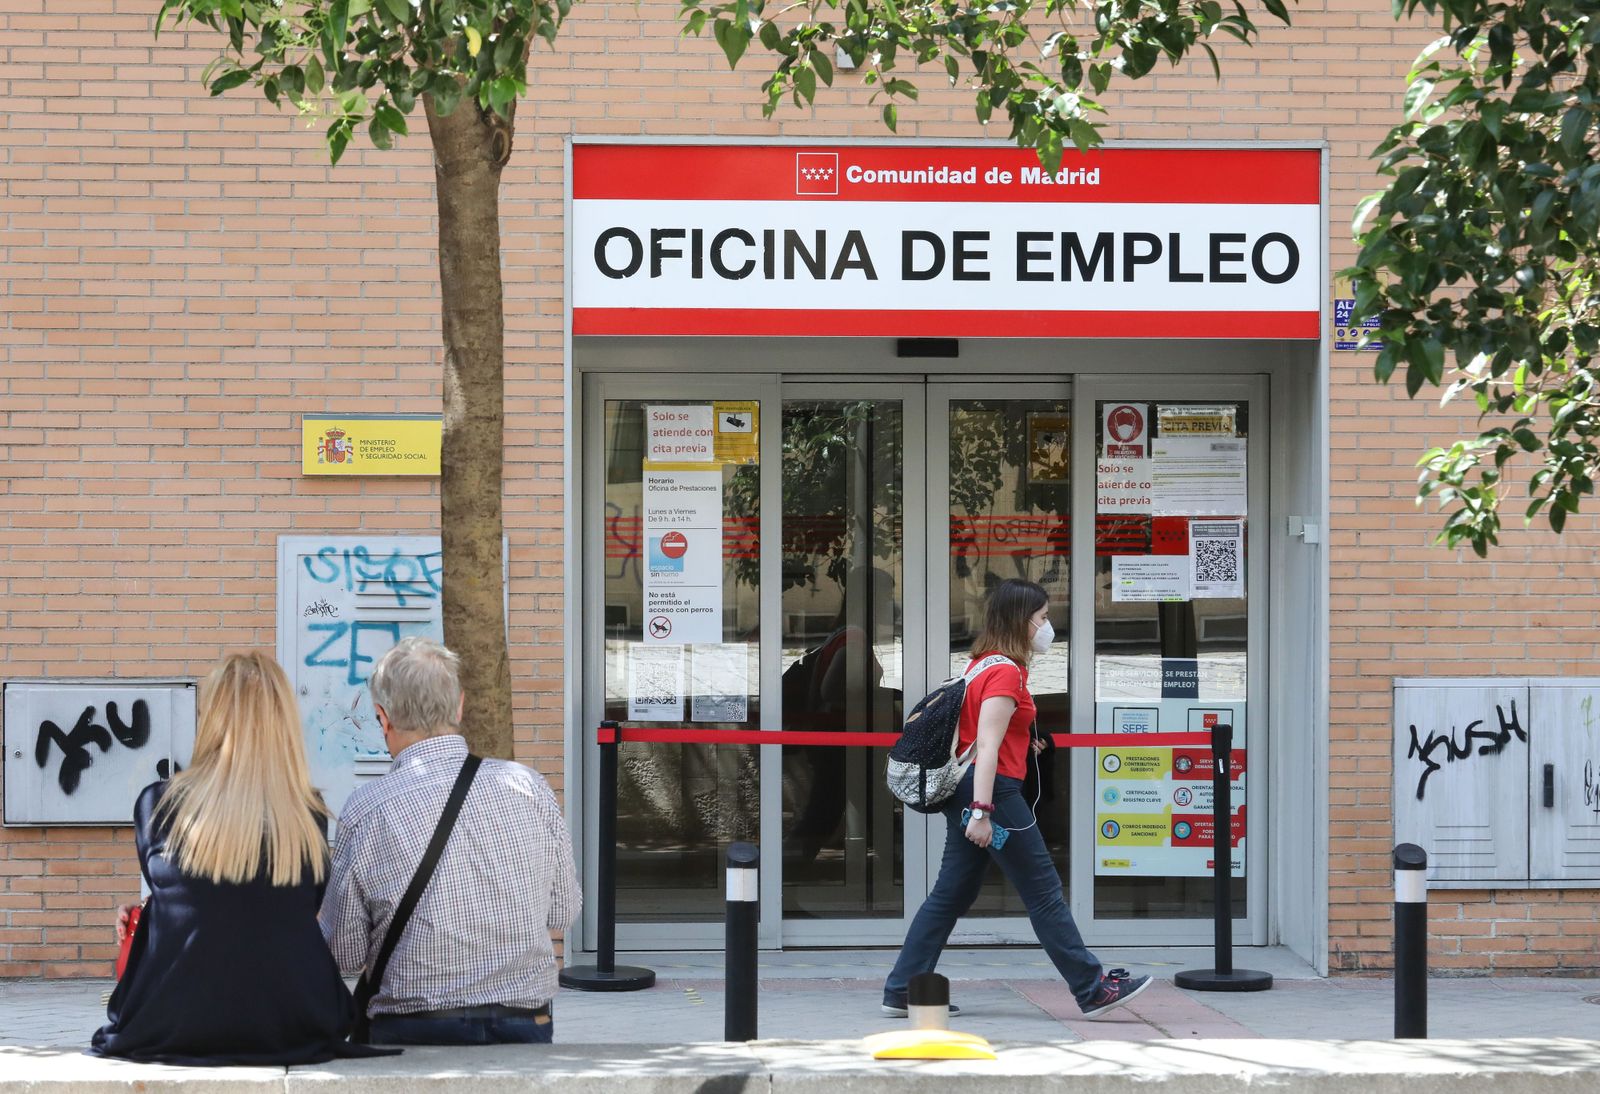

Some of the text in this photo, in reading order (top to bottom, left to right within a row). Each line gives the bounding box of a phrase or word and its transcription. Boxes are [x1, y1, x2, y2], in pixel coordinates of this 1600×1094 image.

[845, 165, 1100, 186] Comunidad de Madrid
[593, 226, 1301, 285] OFICINA DE EMPLEO
[653, 411, 689, 421] Solo se
[1164, 421, 1189, 431] CITA
[653, 428, 713, 437] atiende con
[653, 444, 672, 453] cita
[674, 444, 707, 455] previa
[1098, 464, 1120, 473] Solo
[1098, 480, 1137, 489] atiende
[1098, 496, 1151, 506] cita previa
[648, 599, 682, 607] permitido
[1165, 670, 1174, 678] SE
[1175, 670, 1208, 678] PRESTAN
[1122, 724, 1149, 733] SEPE
